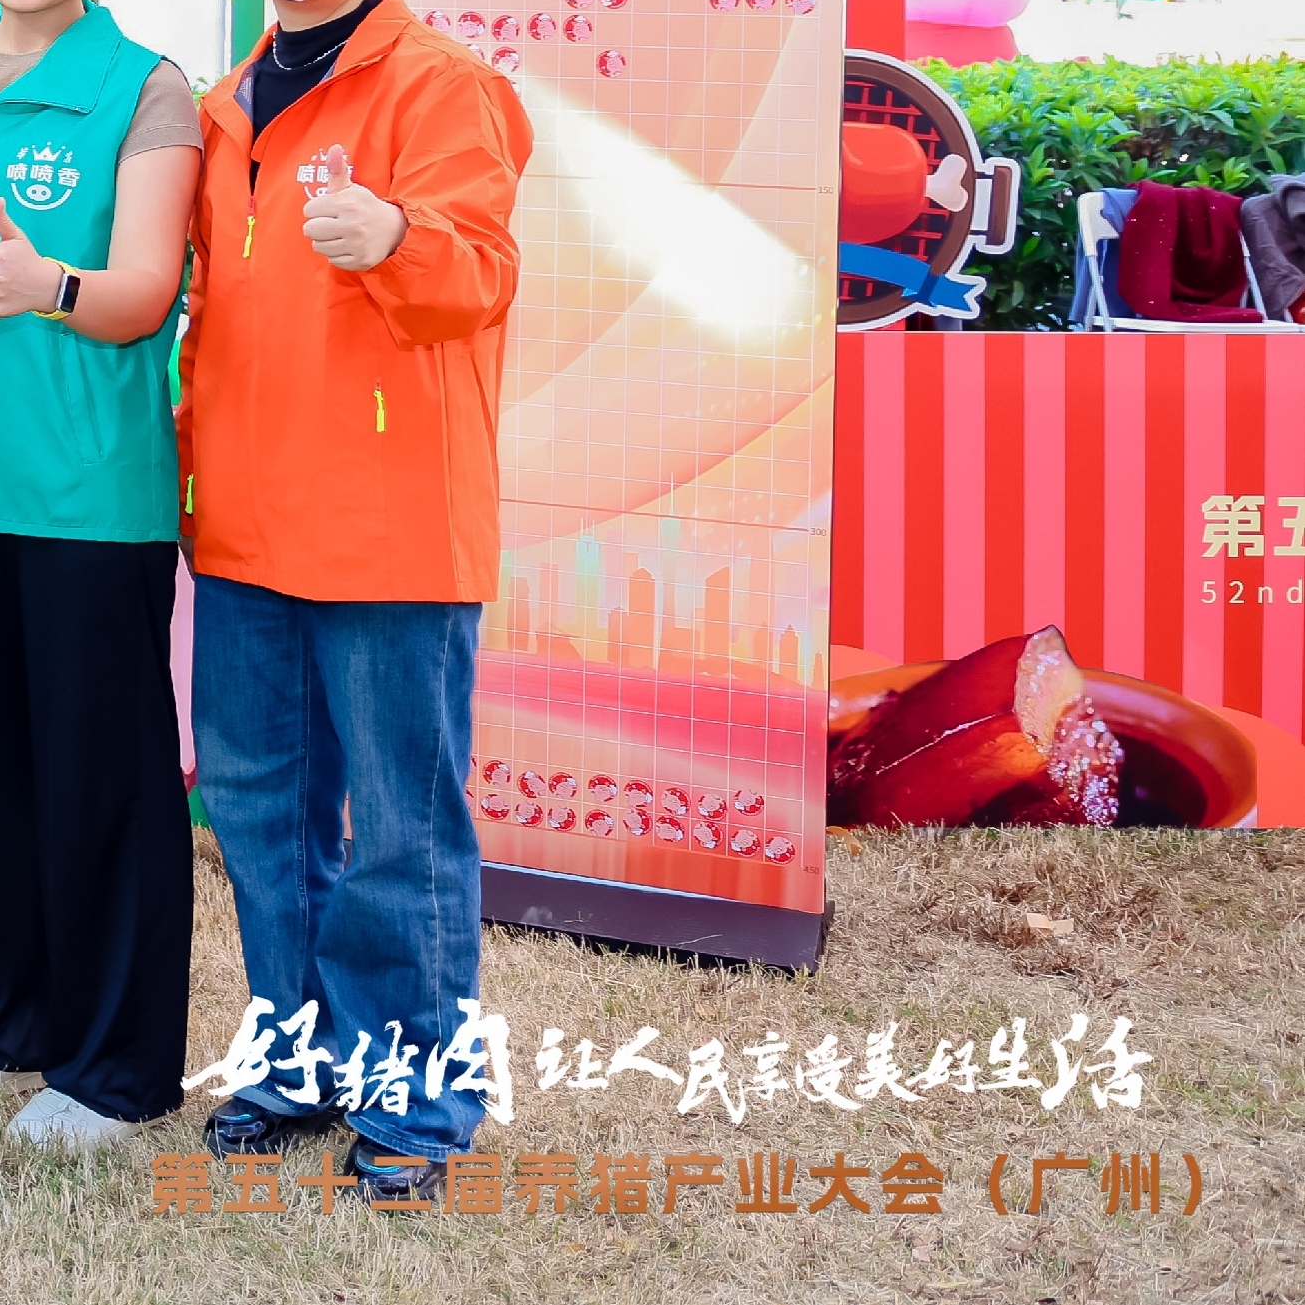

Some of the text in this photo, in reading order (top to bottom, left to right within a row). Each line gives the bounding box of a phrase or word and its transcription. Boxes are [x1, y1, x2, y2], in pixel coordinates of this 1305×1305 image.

[6, 162, 81, 188] 喷喷香
[818, 186, 834, 195] 150
[810, 527, 827, 537] 300
[1201, 578, 1304, 605] 52nd
[803, 865, 820, 875] 450
